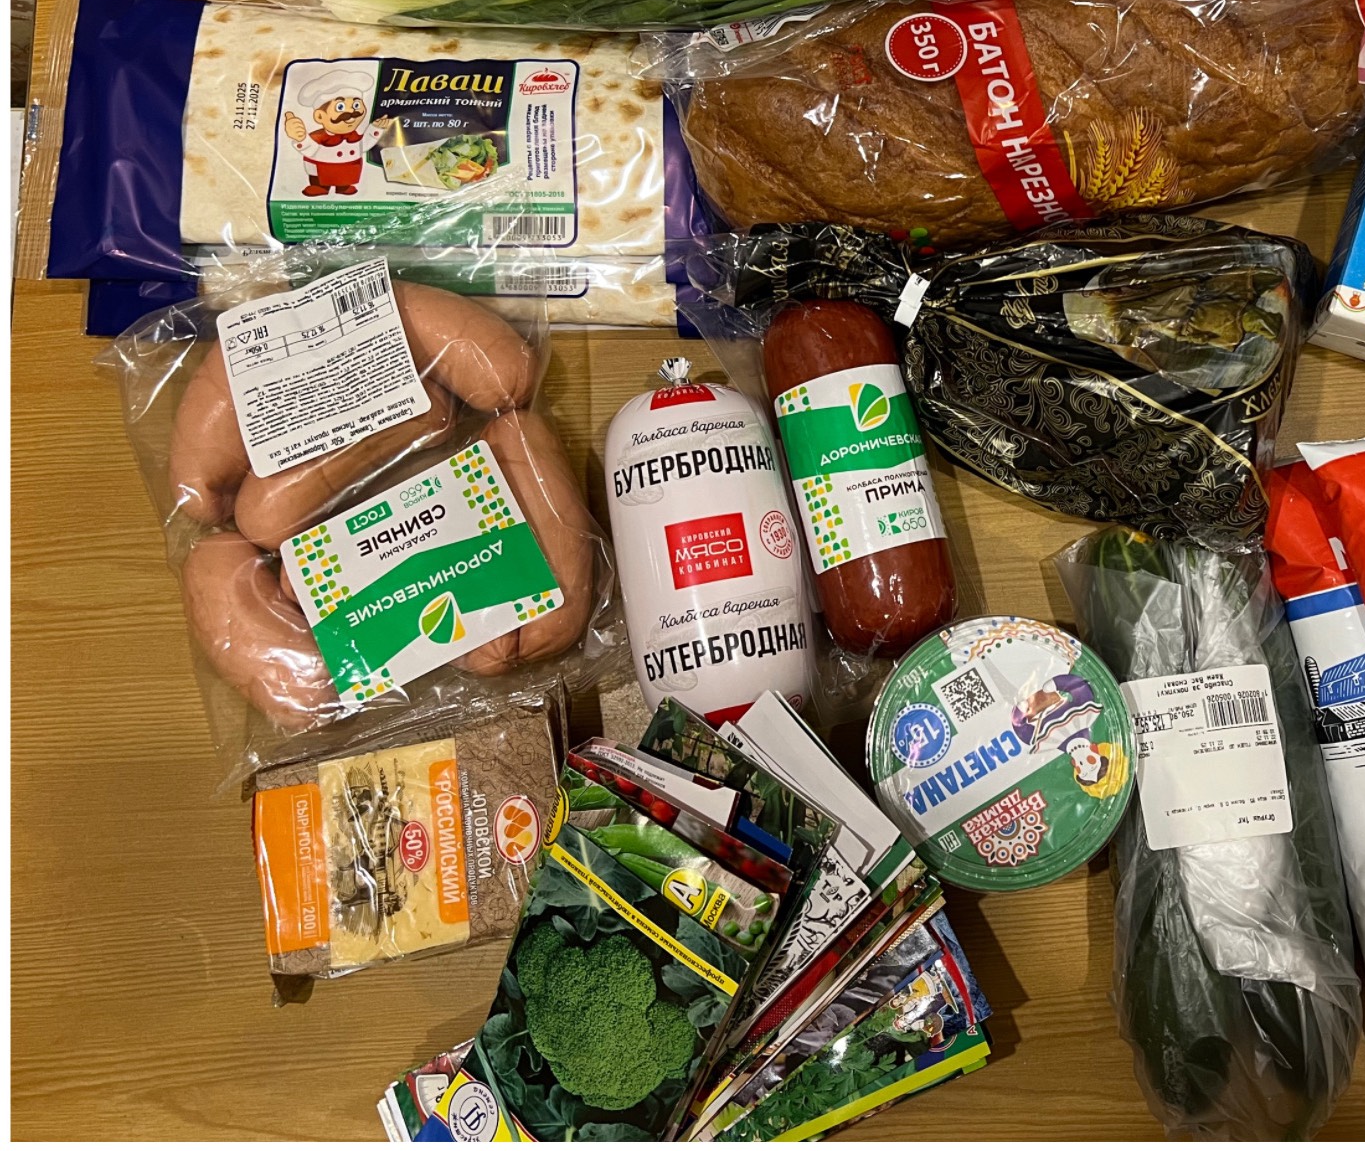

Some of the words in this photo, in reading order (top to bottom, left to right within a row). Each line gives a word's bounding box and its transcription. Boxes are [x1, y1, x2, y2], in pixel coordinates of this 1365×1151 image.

[909, 18, 939, 62] 350
[384, 68, 505, 94] Лаваш
[518, 80, 570, 95] Кировхлеб
[233, 82, 247, 129] 22.11.2025
[246, 83, 260, 130] 27.11.2025
[380, 95, 451, 108] армянский
[454, 98, 503, 108] тонкий
[402, 119, 411, 128] 2
[431, 119, 445, 128] по
[446, 118, 462, 128] 80
[463, 120, 470, 128] г
[966, 17, 1022, 132] БАТОН
[999, 132, 1073, 230] НАРЕЗНО
[377, 406, 412, 425] Сардельки
[631, 426, 689, 447] Колбаса
[690, 419, 746, 436] вареная
[613, 444, 777, 499] БУТЕРБРОДНАЯ
[846, 477, 883, 493] КОЛБАСА
[396, 481, 425, 503] 650
[865, 479, 926, 504] ПРИМА
[347, 504, 387, 531] ГОСТ
[898, 507, 925, 517] КИРОВ
[902, 516, 927, 532] 650
[354, 501, 448, 557] СВИНЫЕ
[377, 526, 439, 561] САРДЕЛЬКИ
[680, 527, 732, 545] КИРОВСКИЙ
[674, 537, 744, 564] МЯСО
[678, 555, 744, 576] КОМБИНАТ
[342, 537, 507, 628] ДОРОНИЧЕВСКИЕ
[658, 607, 720, 631] Колбаса
[721, 596, 782, 617] вареная
[643, 621, 808, 683] БУТЕРБРОДНАЯ
[1203, 679, 1233, 689] Спасибо
[905, 728, 1022, 817] СМЕТАНА
[296, 799, 307, 826] СЫР
[960, 788, 1025, 834] дымка
[969, 788, 1047, 847] Вятская
[298, 831, 311, 861] ГОСТ
[404, 828, 423, 865] 50%
[434, 779, 464, 904] РОССИЙСКИЙ
[460, 771, 470, 810] КОМБИНАТ
[466, 859, 477, 905] ПРОДУКТОВ
[471, 793, 495, 879] ЮГОВСКОЙ
[558, 853, 589, 882] упаковке
[586, 875, 632, 917] любительской
[302, 906, 315, 929] 200
[633, 916, 660, 940] семена
[658, 934, 724, 987] профессиональные
